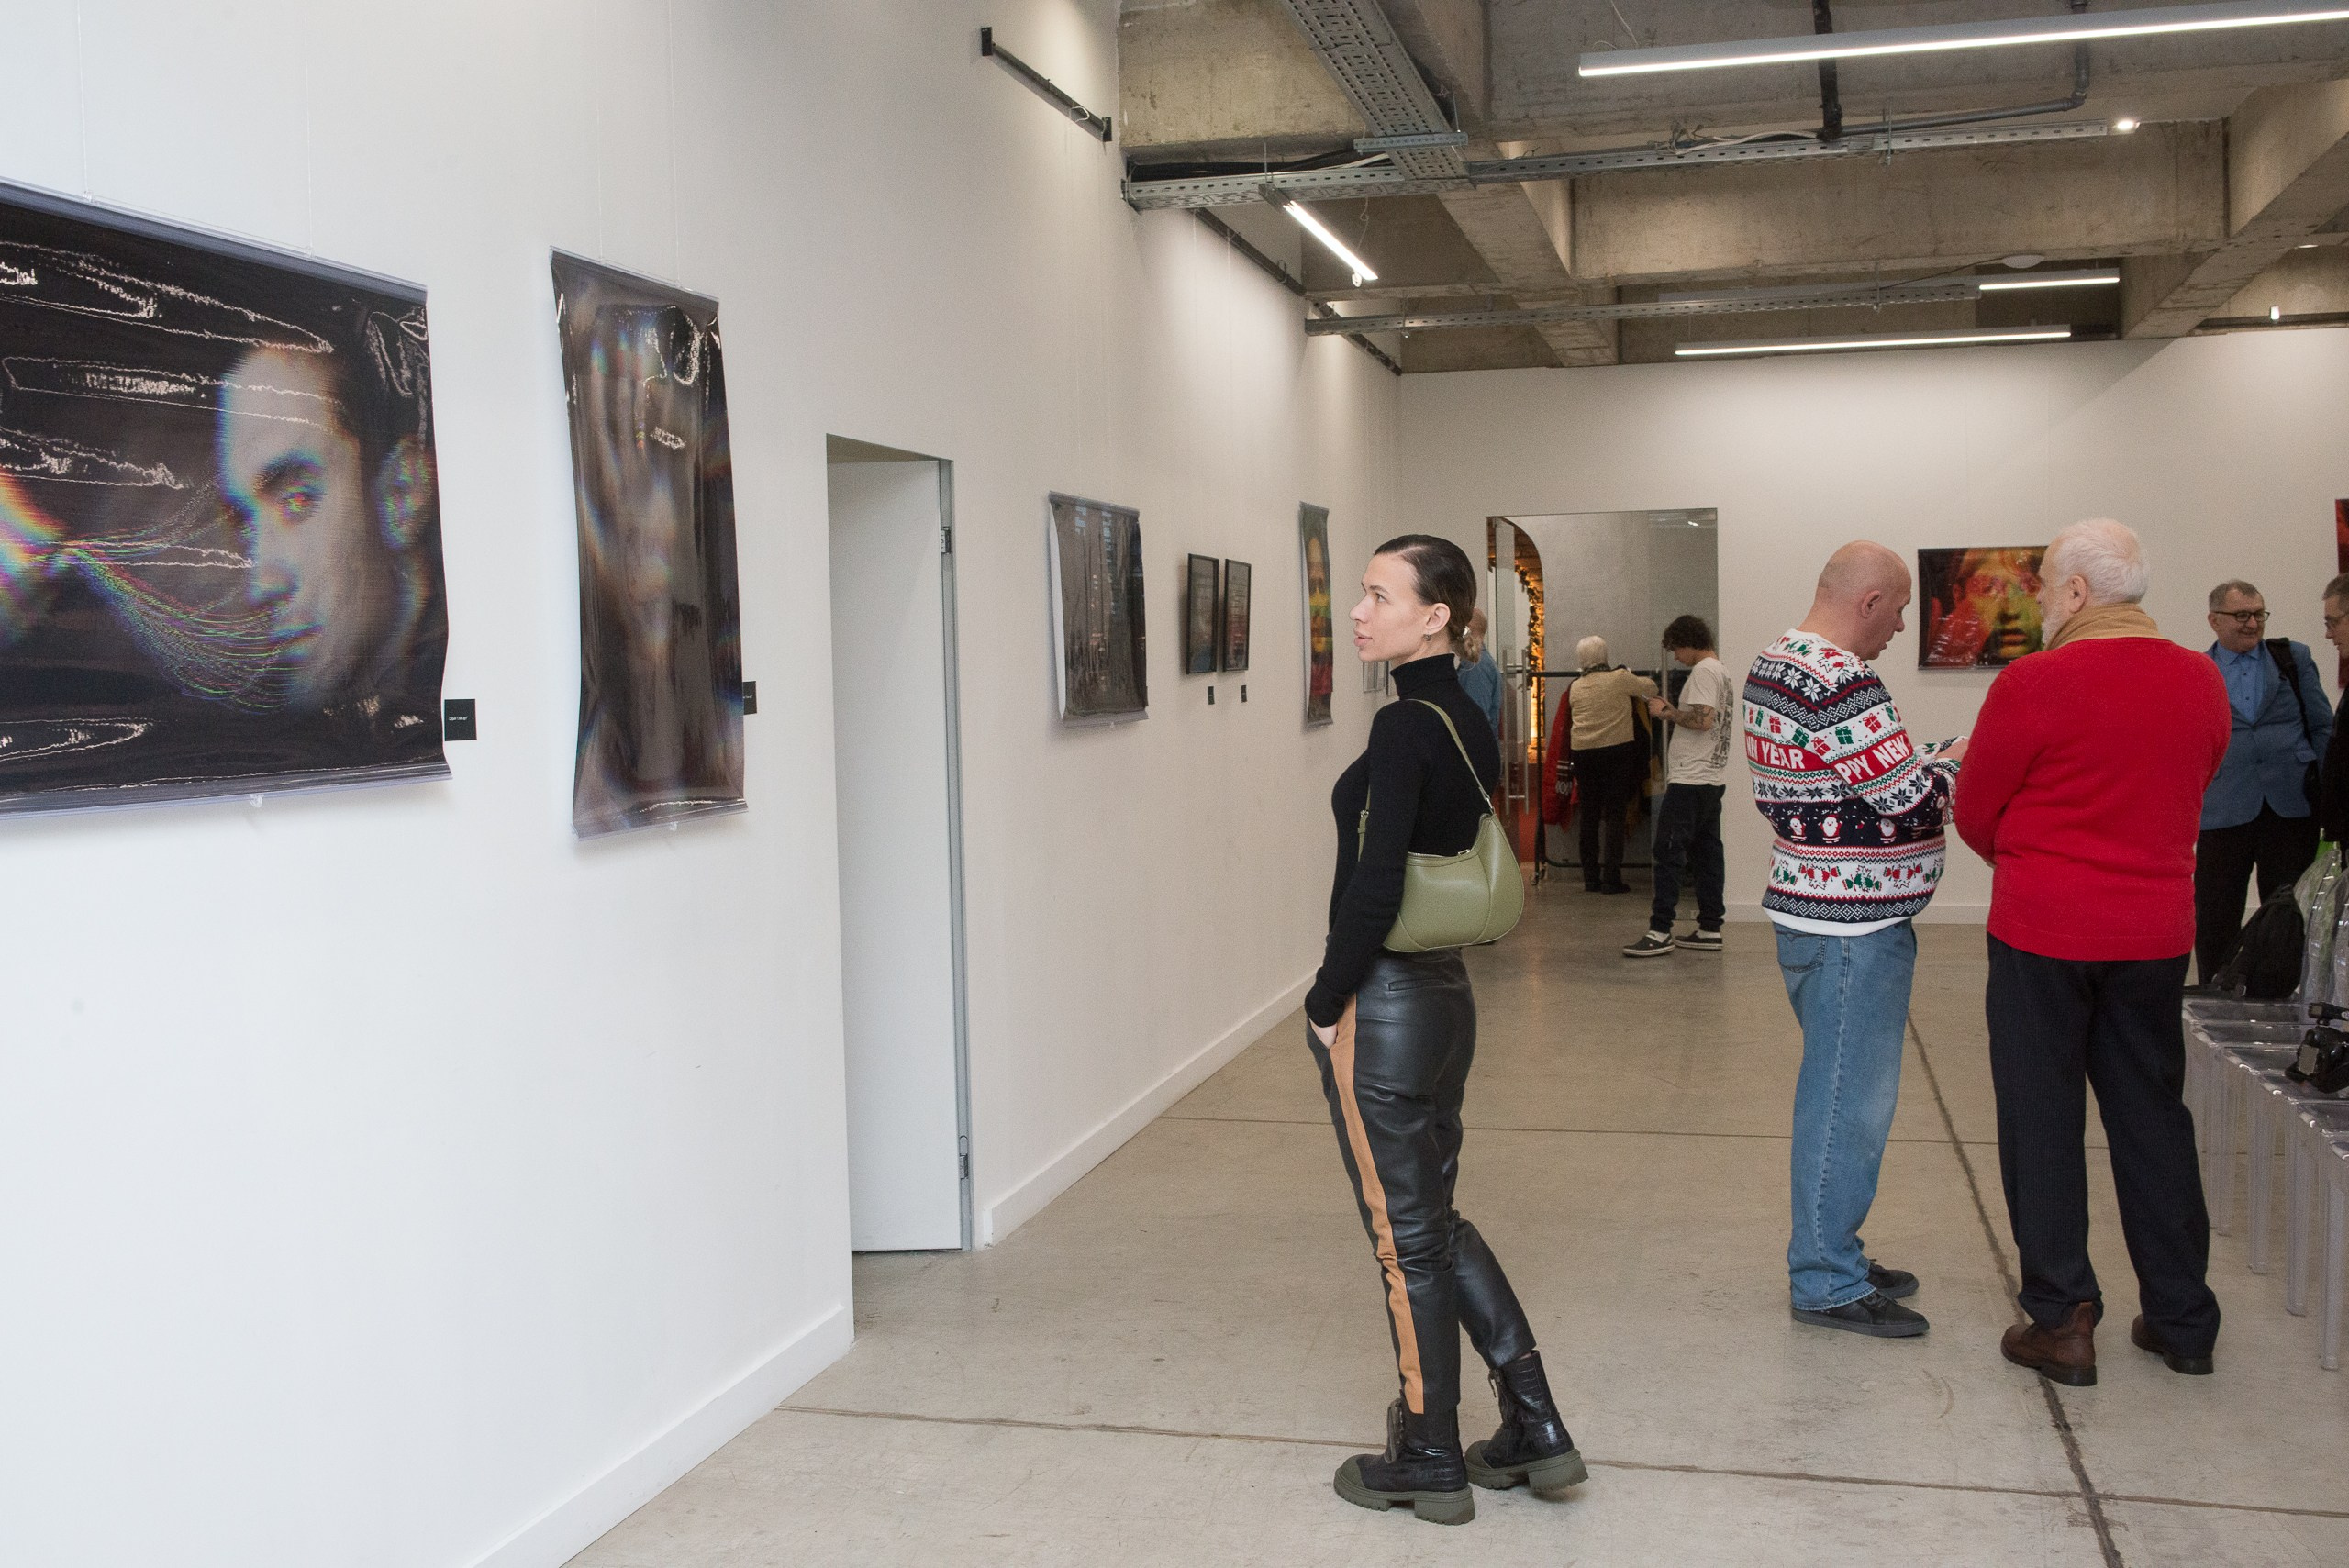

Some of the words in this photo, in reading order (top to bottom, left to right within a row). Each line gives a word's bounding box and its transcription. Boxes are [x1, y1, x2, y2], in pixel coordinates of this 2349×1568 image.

[1761, 740, 1806, 770] YEAR
[1834, 754, 1876, 784] PPY
[1872, 734, 1910, 770] NEW
